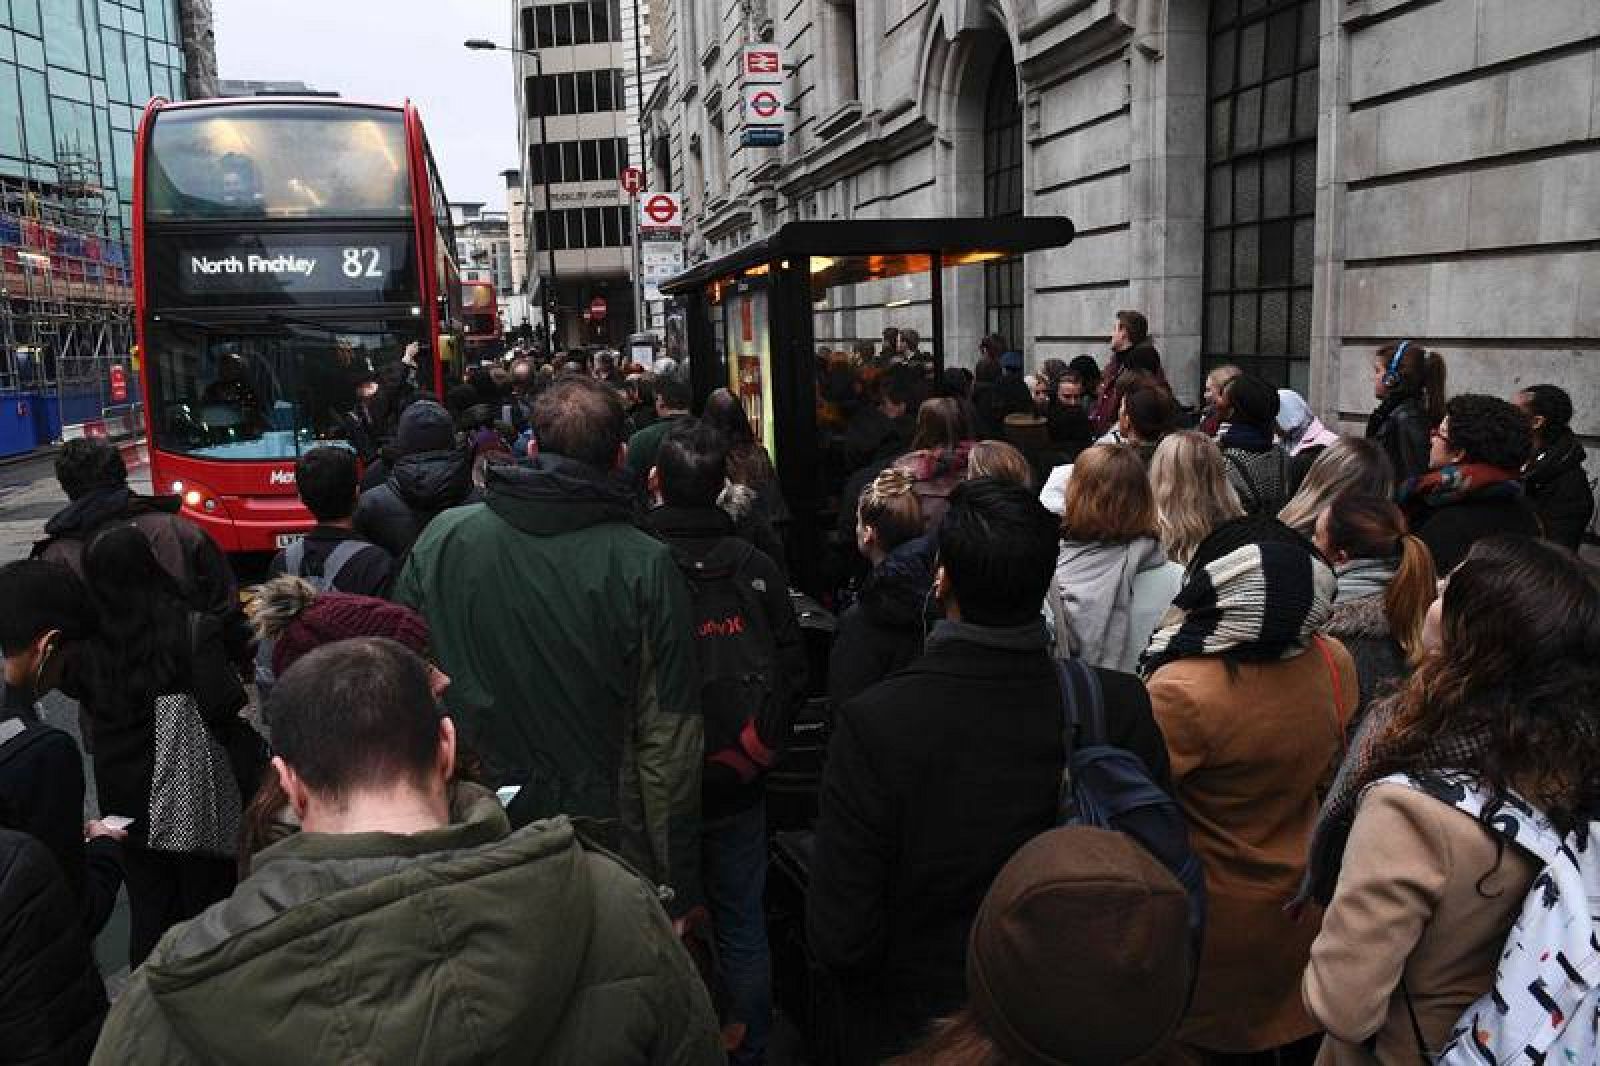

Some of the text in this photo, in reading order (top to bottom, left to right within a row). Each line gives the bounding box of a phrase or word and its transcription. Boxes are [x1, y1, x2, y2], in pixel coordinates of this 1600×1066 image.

[191, 246, 383, 278] North Finchley 82
